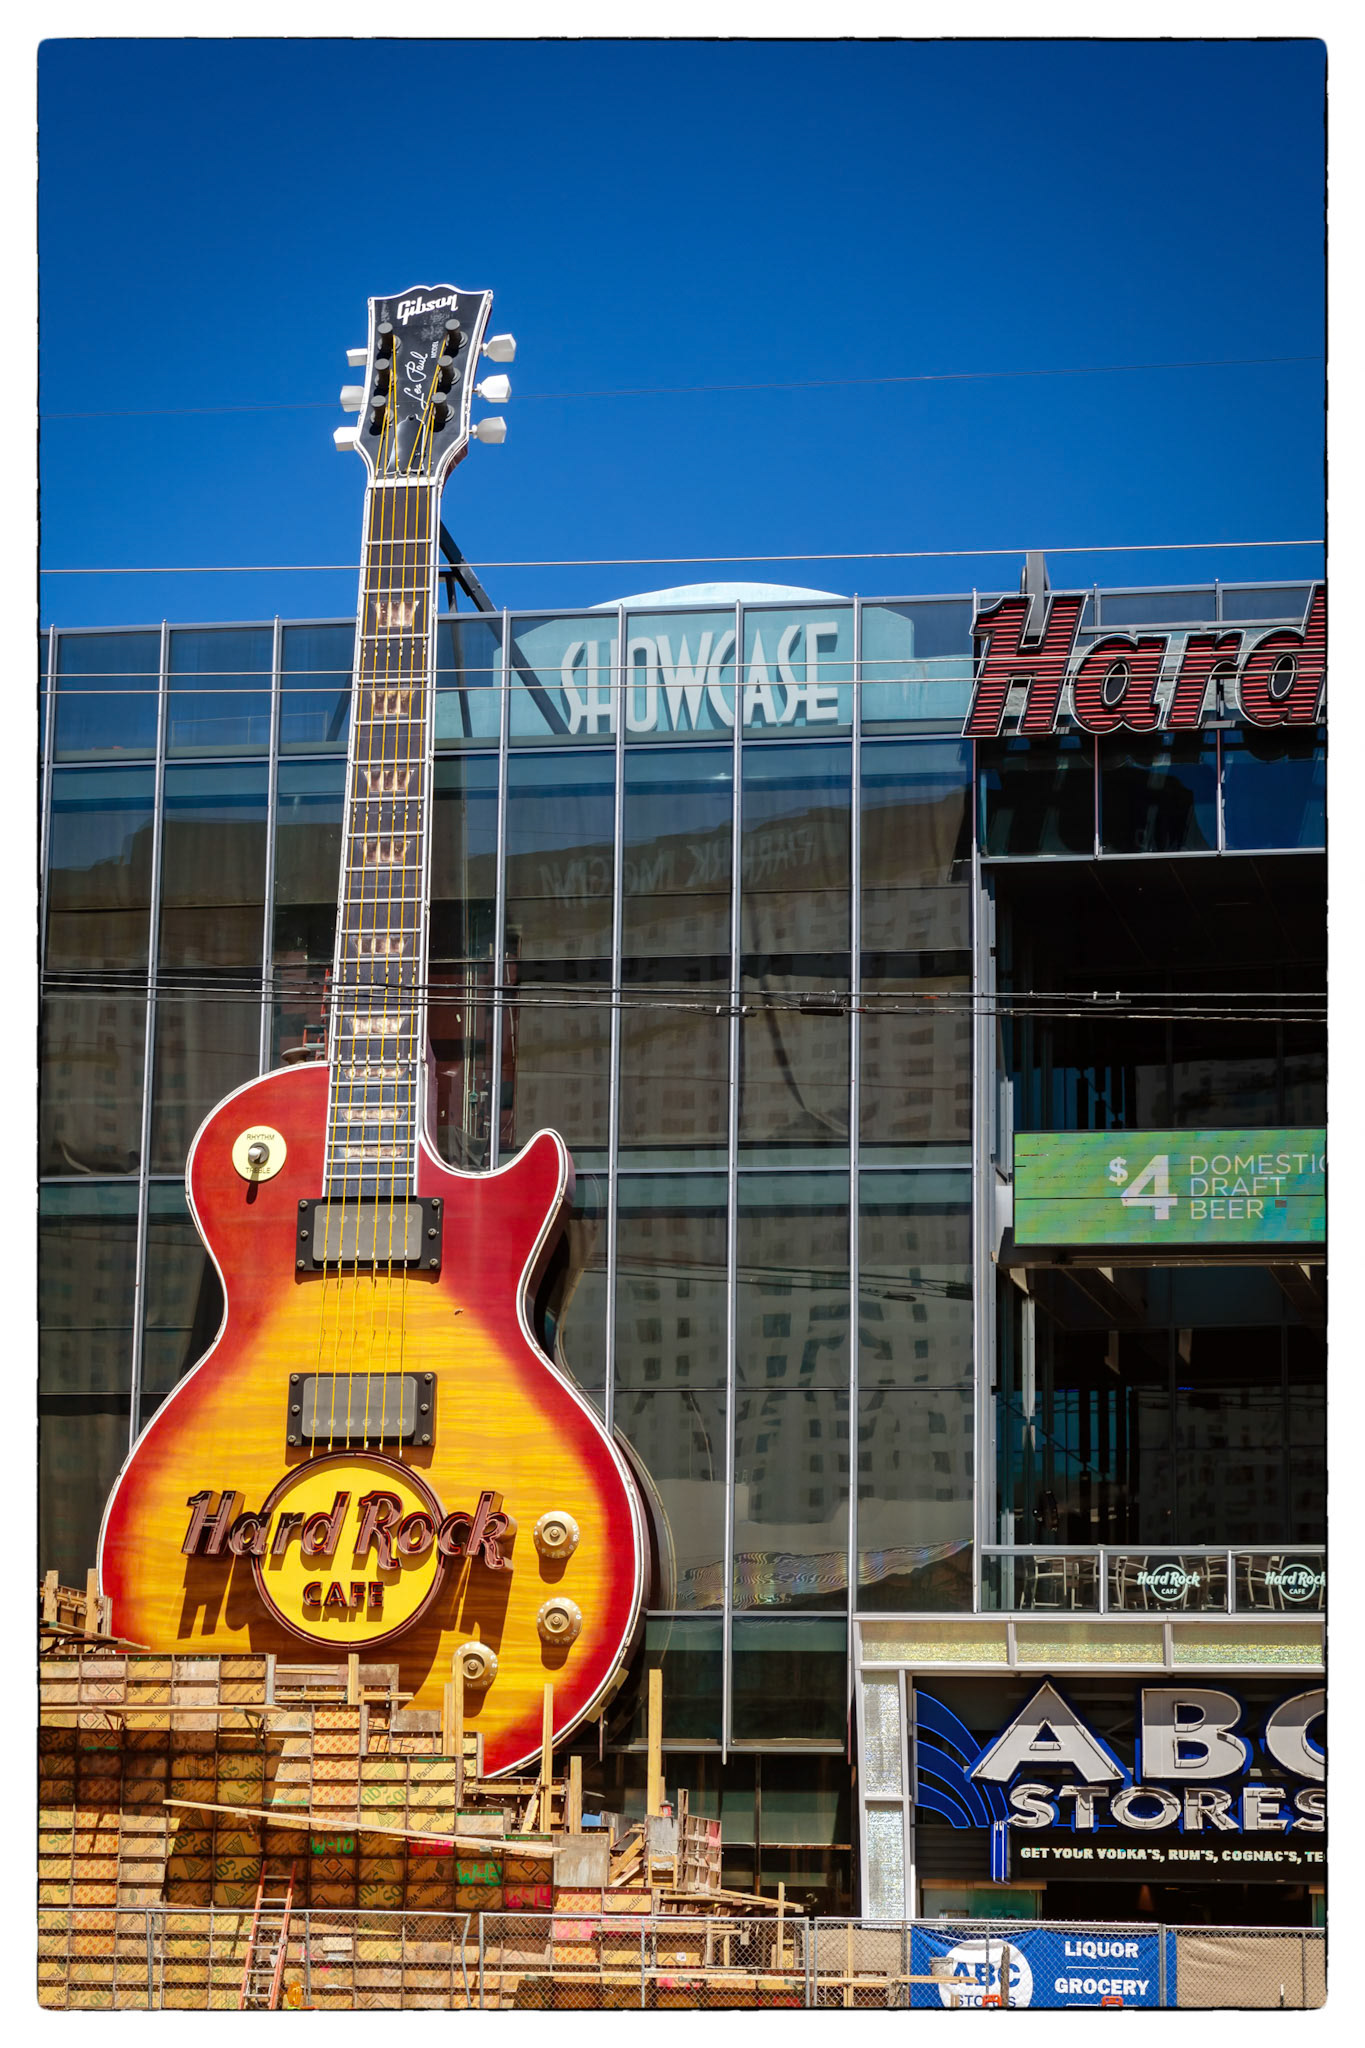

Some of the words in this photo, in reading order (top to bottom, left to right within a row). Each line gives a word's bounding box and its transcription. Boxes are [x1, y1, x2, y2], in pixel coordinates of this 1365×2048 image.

[397, 294, 459, 325] Gibson
[431, 341, 439, 359] MODEL
[404, 350, 428, 382] Paul
[403, 383, 429, 411] Les
[962, 582, 1326, 738] Hard
[561, 621, 838, 735] SHOWCASE
[246, 1133, 275, 1141] RHYTHM
[1109, 1154, 1178, 1220] $4
[1190, 1176, 1286, 1197] DRAFT
[1190, 1199, 1264, 1220] BEER
[181, 1490, 350, 1557] Hard
[353, 1490, 514, 1572] Rock
[1137, 1571, 1170, 1586] Hard
[1170, 1571, 1201, 1588] Rock
[1264, 1571, 1297, 1586] Hard
[303, 1581, 385, 1608] CAFE
[311, 1836, 354, 1855] W-10
[1020, 1848, 1049, 1859] GET
[1052, 1848, 1094, 1860] YOUR
[1097, 1849, 1165, 1863] VODKA'S,
[1168, 1850, 1219, 1864] RUM'S,
[1222, 1850, 1302, 1864] COGNAC'S,
[1064, 1940, 1139, 1960] LIQUOR
[1053, 1977, 1150, 1996] GROCERY
